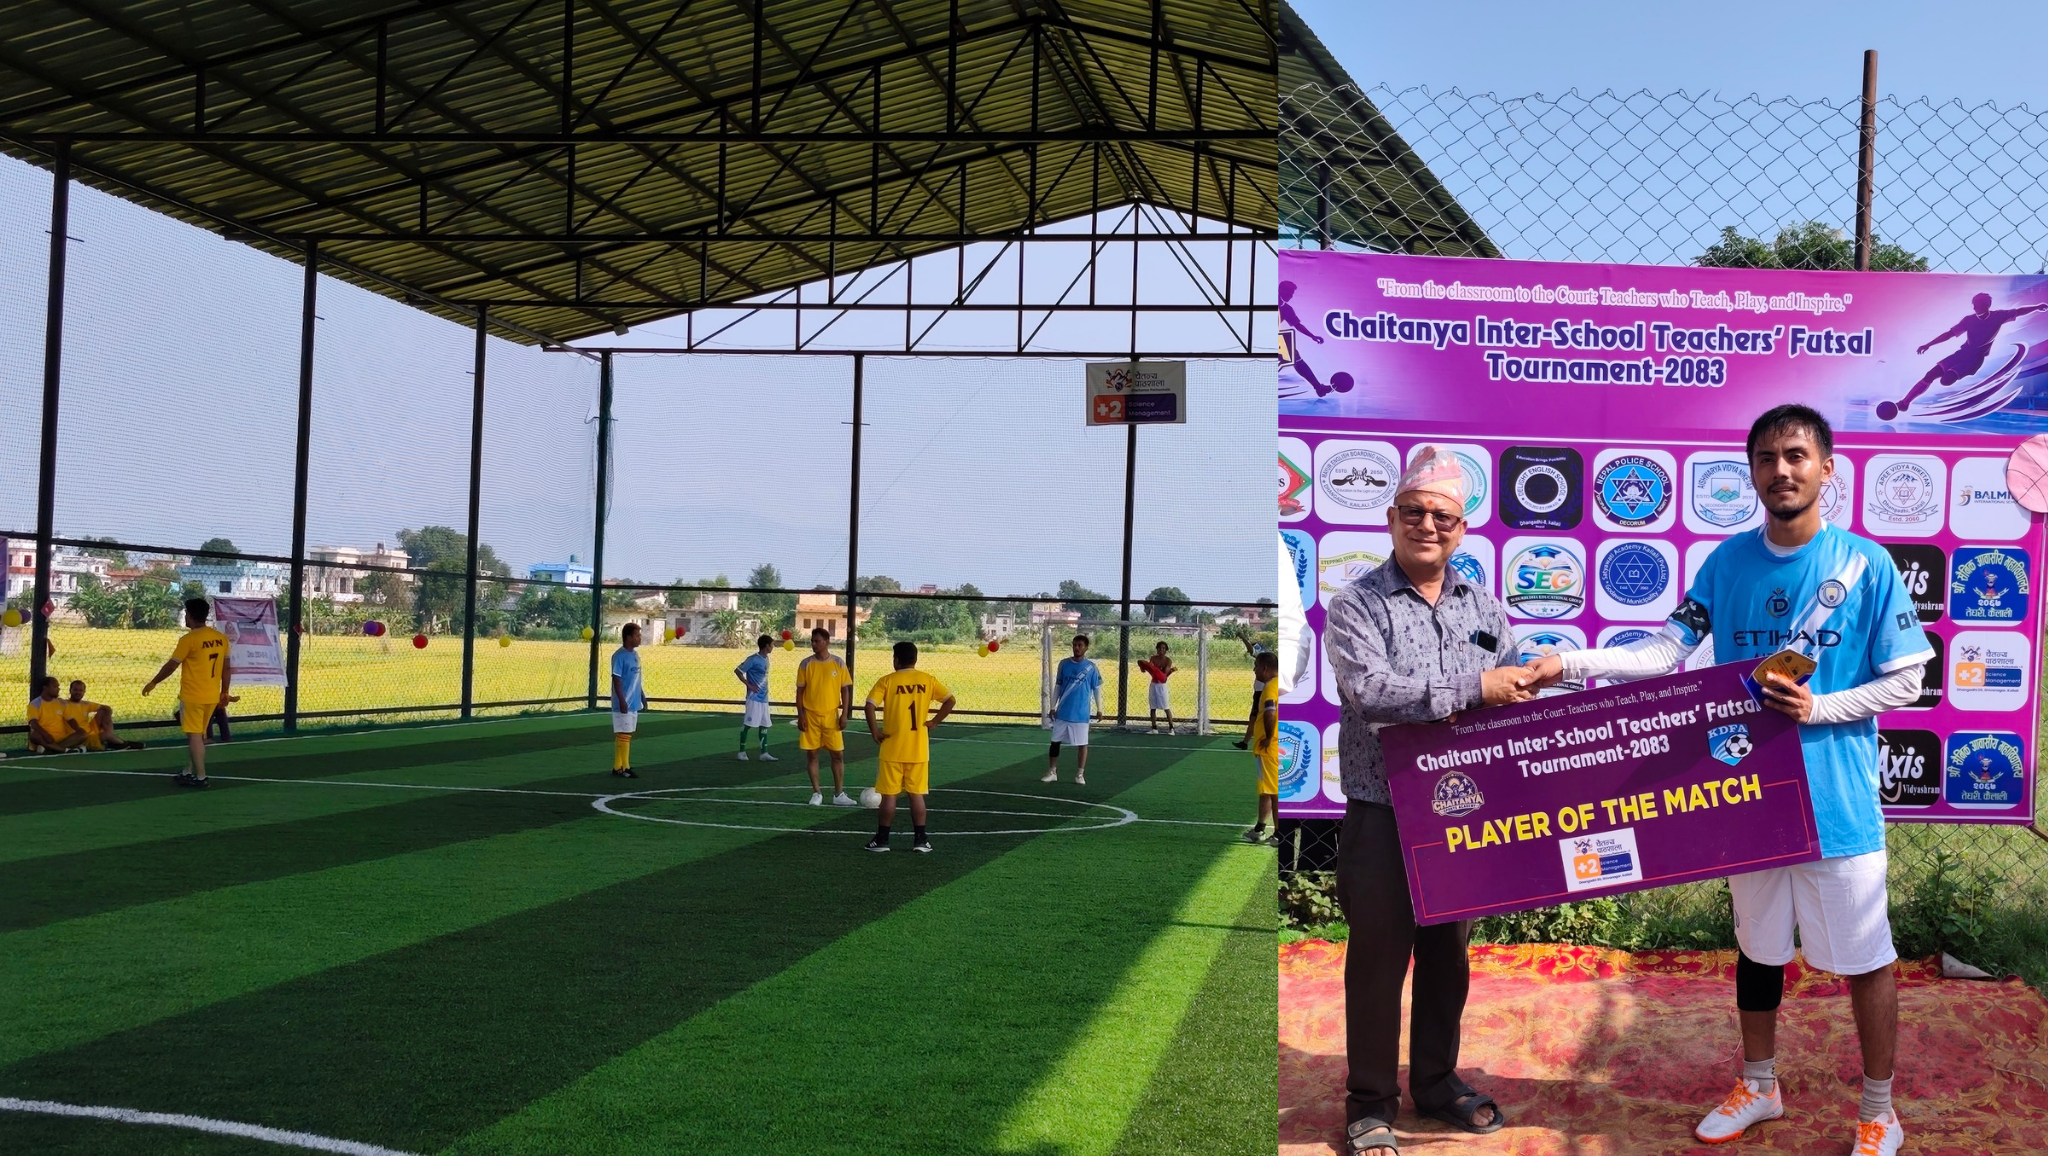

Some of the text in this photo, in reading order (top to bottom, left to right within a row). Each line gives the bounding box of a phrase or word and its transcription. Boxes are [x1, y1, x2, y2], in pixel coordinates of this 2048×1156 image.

[1378, 279, 1852, 315] "From the classroom to the Court: Teachers who Teach, Play, and Inspire."
[1325, 310, 1468, 349] Chaitanya
[1477, 316, 1646, 350] Inter-School
[1789, 325, 1874, 358] Futsal
[1486, 352, 1726, 387] Tournament-2083
[1097, 401, 1122, 418] +2
[1128, 410, 1171, 418] Management
[1330, 452, 1350, 466] ENGLISH
[1350, 451, 1375, 459] BOARDING
[1375, 455, 1386, 466] HIGH
[1596, 457, 1669, 487] NEPAL POLICE SCHOOL
[1721, 464, 1739, 474] VIDYA
[1879, 464, 1930, 487] APEE VIDYA NIKETAN
[1517, 467, 1566, 497] DELIGHT ENGLISH SCHOOL
[1833, 473, 1847, 492] HOOL
[1911, 500, 1926, 512] Kailali
[1344, 554, 1357, 562] STONE
[1362, 554, 1381, 563] ENGLISH
[1613, 544, 1642, 555] Academy
[1643, 545, 1659, 558] Kailali
[1517, 570, 1571, 589] SEG
[1901, 562, 1929, 595] is
[1539, 594, 1568, 602] EDUCATIONAL
[1626, 591, 1659, 604] Municipality
[1914, 601, 1944, 612] dyashram
[202, 639, 223, 649] AVN
[1615, 632, 1642, 642] Academy
[1733, 629, 1842, 647] ETIHAD
[208, 653, 219, 678] 7
[1958, 667, 1982, 683] +2
[895, 683, 927, 695] AVN
[908, 700, 918, 731] 1
[1451, 680, 1703, 736] "From the classroom to the Court: Teachers who Teach, Play, and Inspire."
[1707, 724, 1748, 739] KDFA
[1416, 744, 1504, 772] Chaitanya
[1508, 721, 1613, 757] Inter-School
[1518, 734, 1670, 777] Tournament-2083
[1878, 745, 1925, 790] Axis
[1902, 784, 1940, 796] Vidyashram
[1433, 794, 1483, 811] CHAITANYA
[1446, 774, 1762, 853] PLAYER OF THE MATCH
[1578, 858, 1599, 874] +2
[1601, 863, 1632, 871] Management
